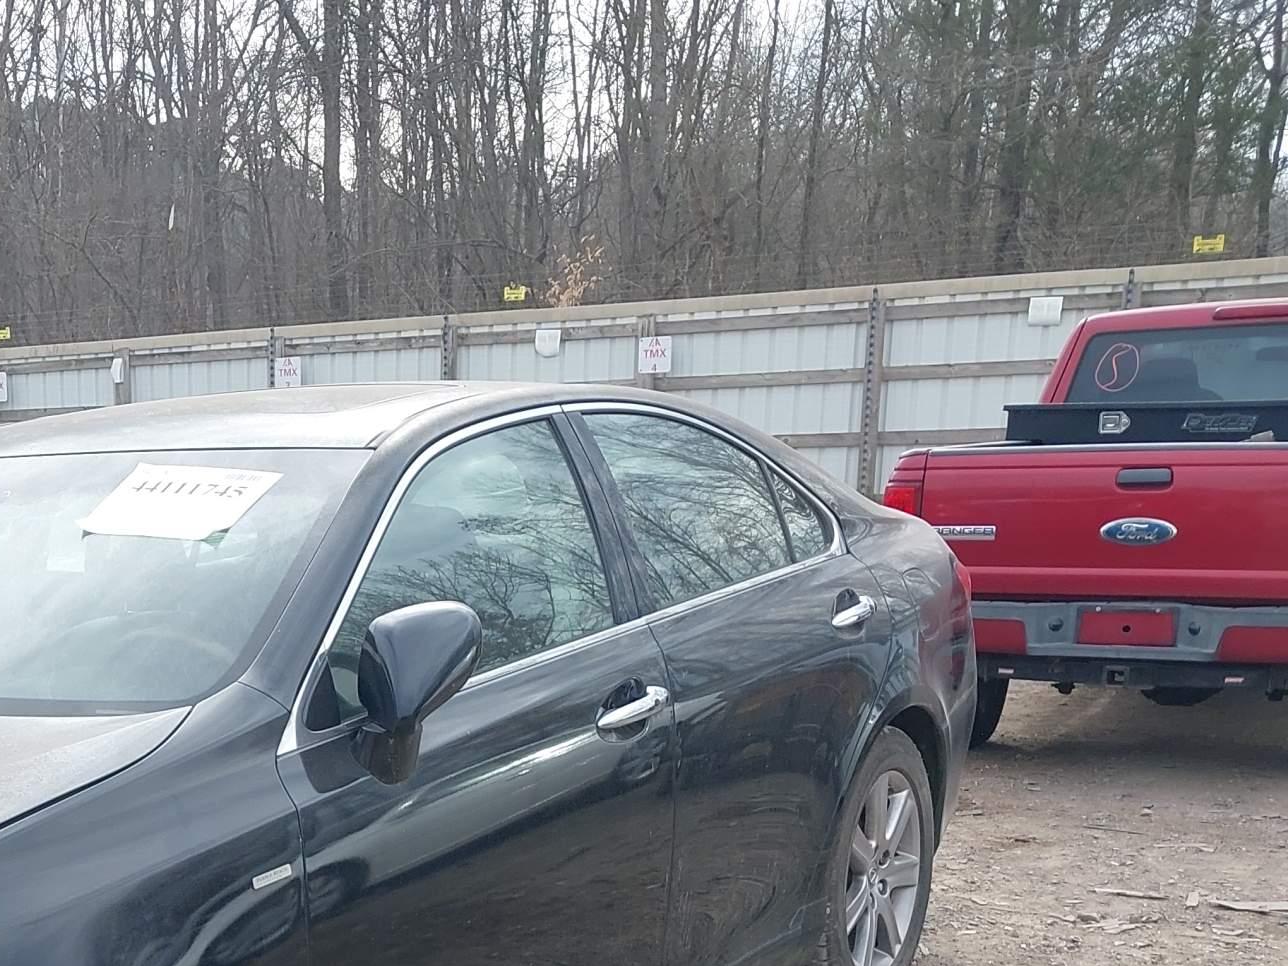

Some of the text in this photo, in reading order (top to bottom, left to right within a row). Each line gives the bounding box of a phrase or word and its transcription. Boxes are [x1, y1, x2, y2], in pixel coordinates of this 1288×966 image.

[643, 348, 667, 359] TMX
[278, 368, 298, 377] TMX
[1116, 523, 1160, 540] Ford
